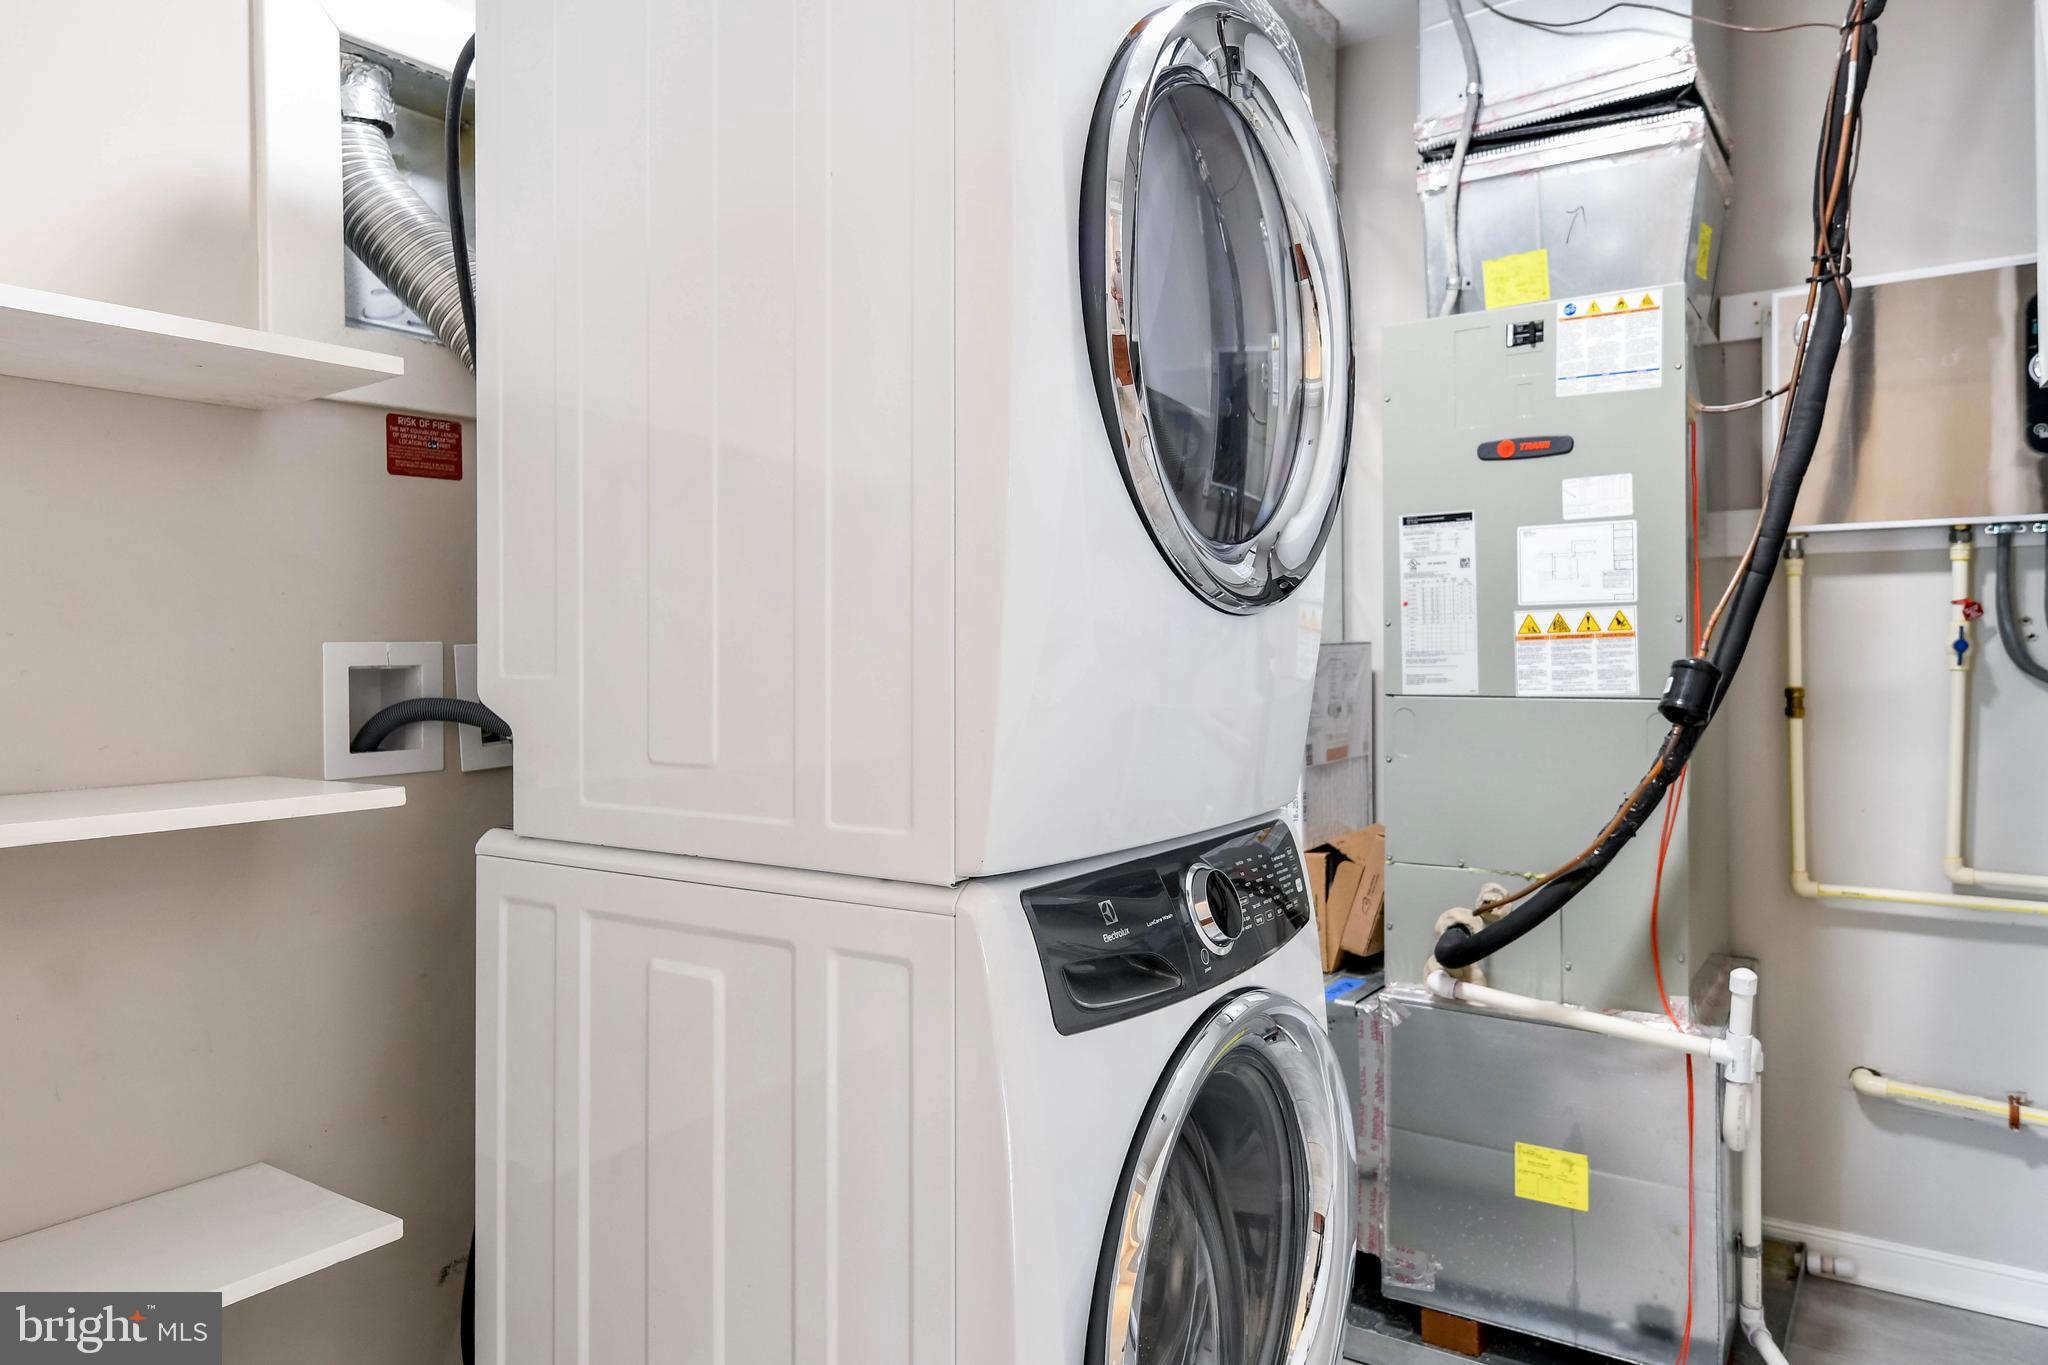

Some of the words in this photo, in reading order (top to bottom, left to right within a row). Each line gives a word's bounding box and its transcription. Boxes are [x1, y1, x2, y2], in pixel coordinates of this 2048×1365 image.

[398, 417, 417, 427] RISK
[419, 419, 430, 428] OF
[432, 421, 451, 431] FIRE
[398, 438, 422, 446] LOCATION
[1102, 928, 1130, 943] Electrolux
